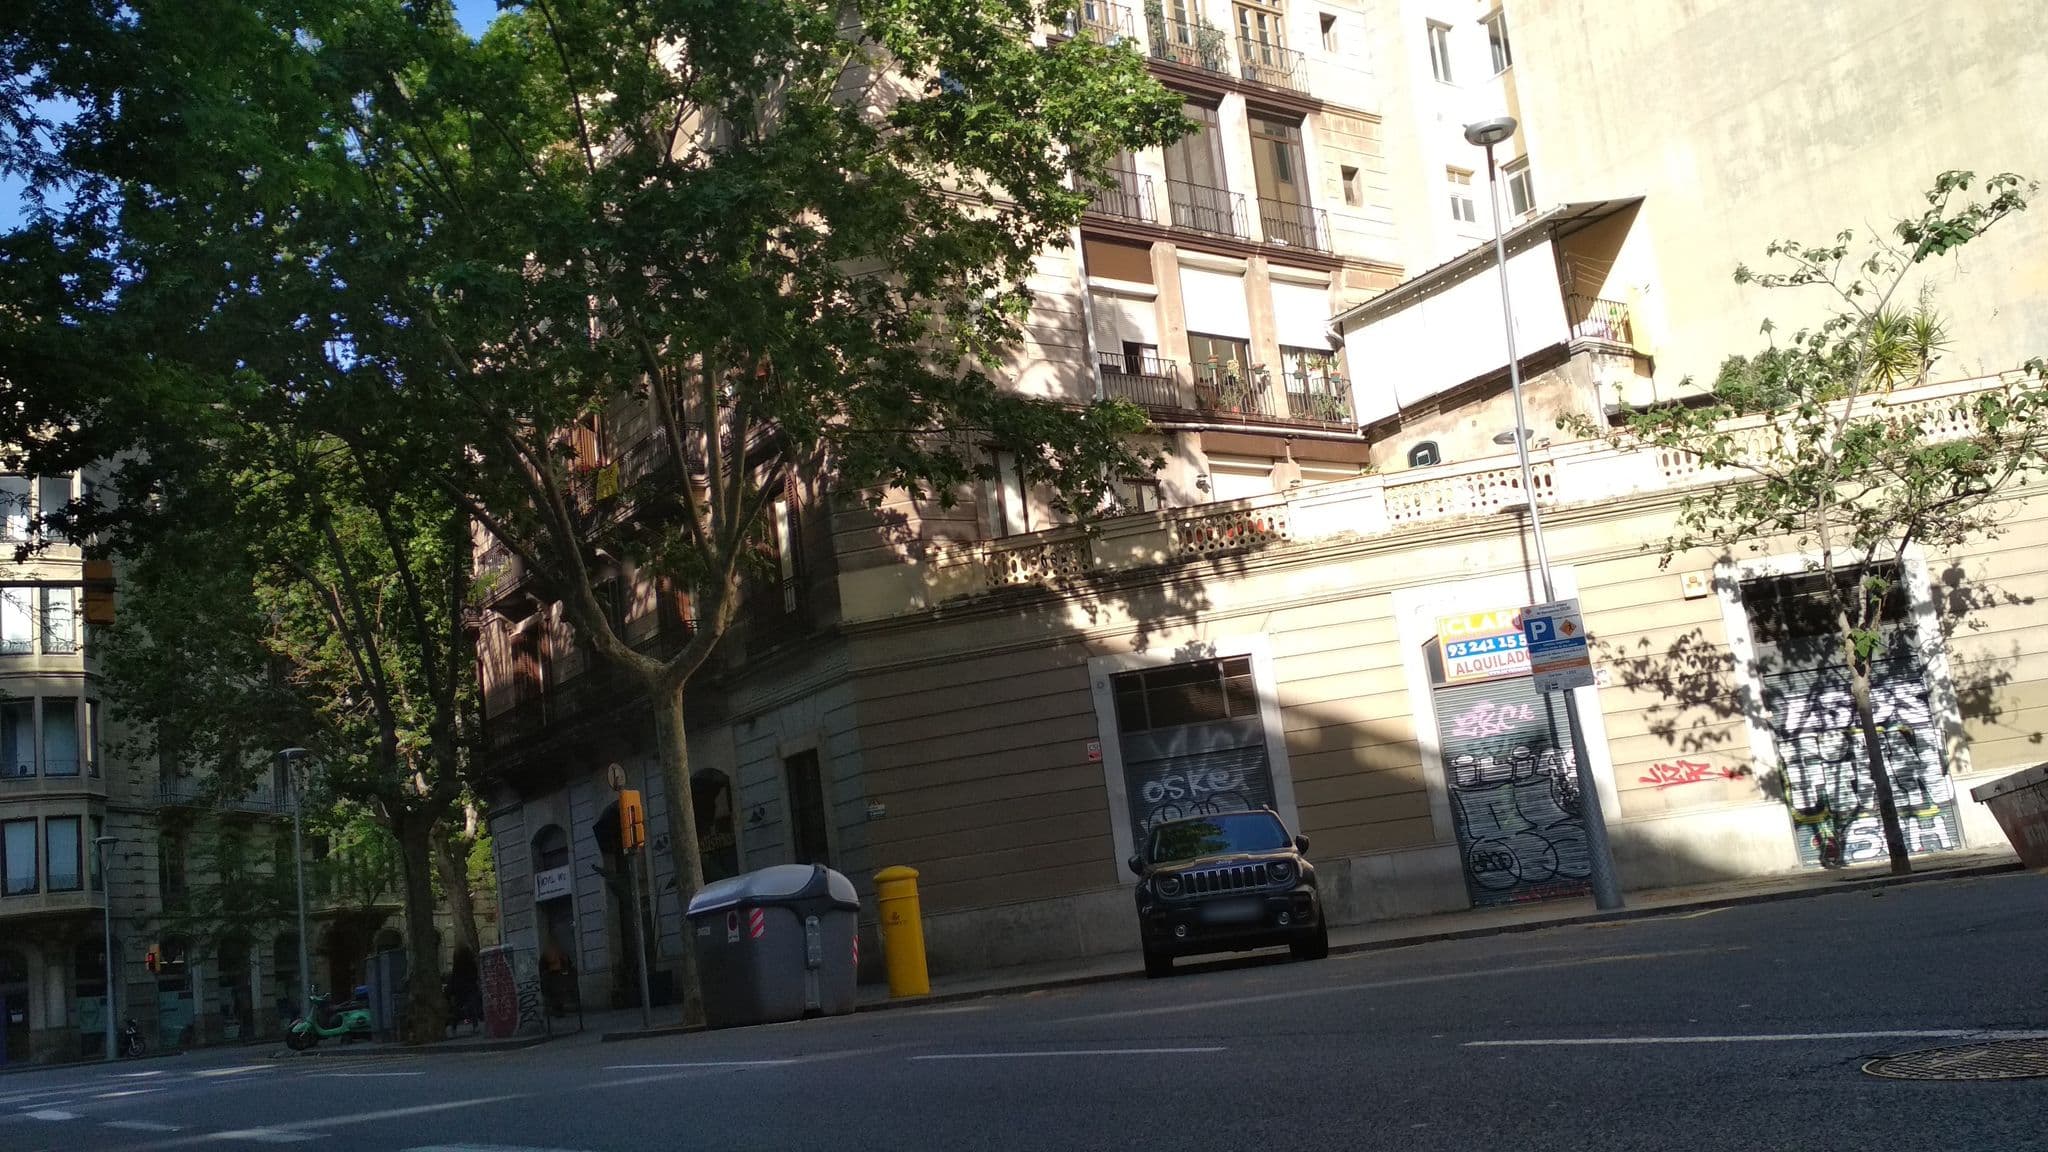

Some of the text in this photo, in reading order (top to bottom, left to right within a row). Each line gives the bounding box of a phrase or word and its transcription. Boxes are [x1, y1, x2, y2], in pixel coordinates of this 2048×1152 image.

[1530, 621, 1547, 641] P
[1447, 642, 1467, 657] 93
[1468, 639, 1496, 653] 241
[1498, 635, 1517, 649] 15
